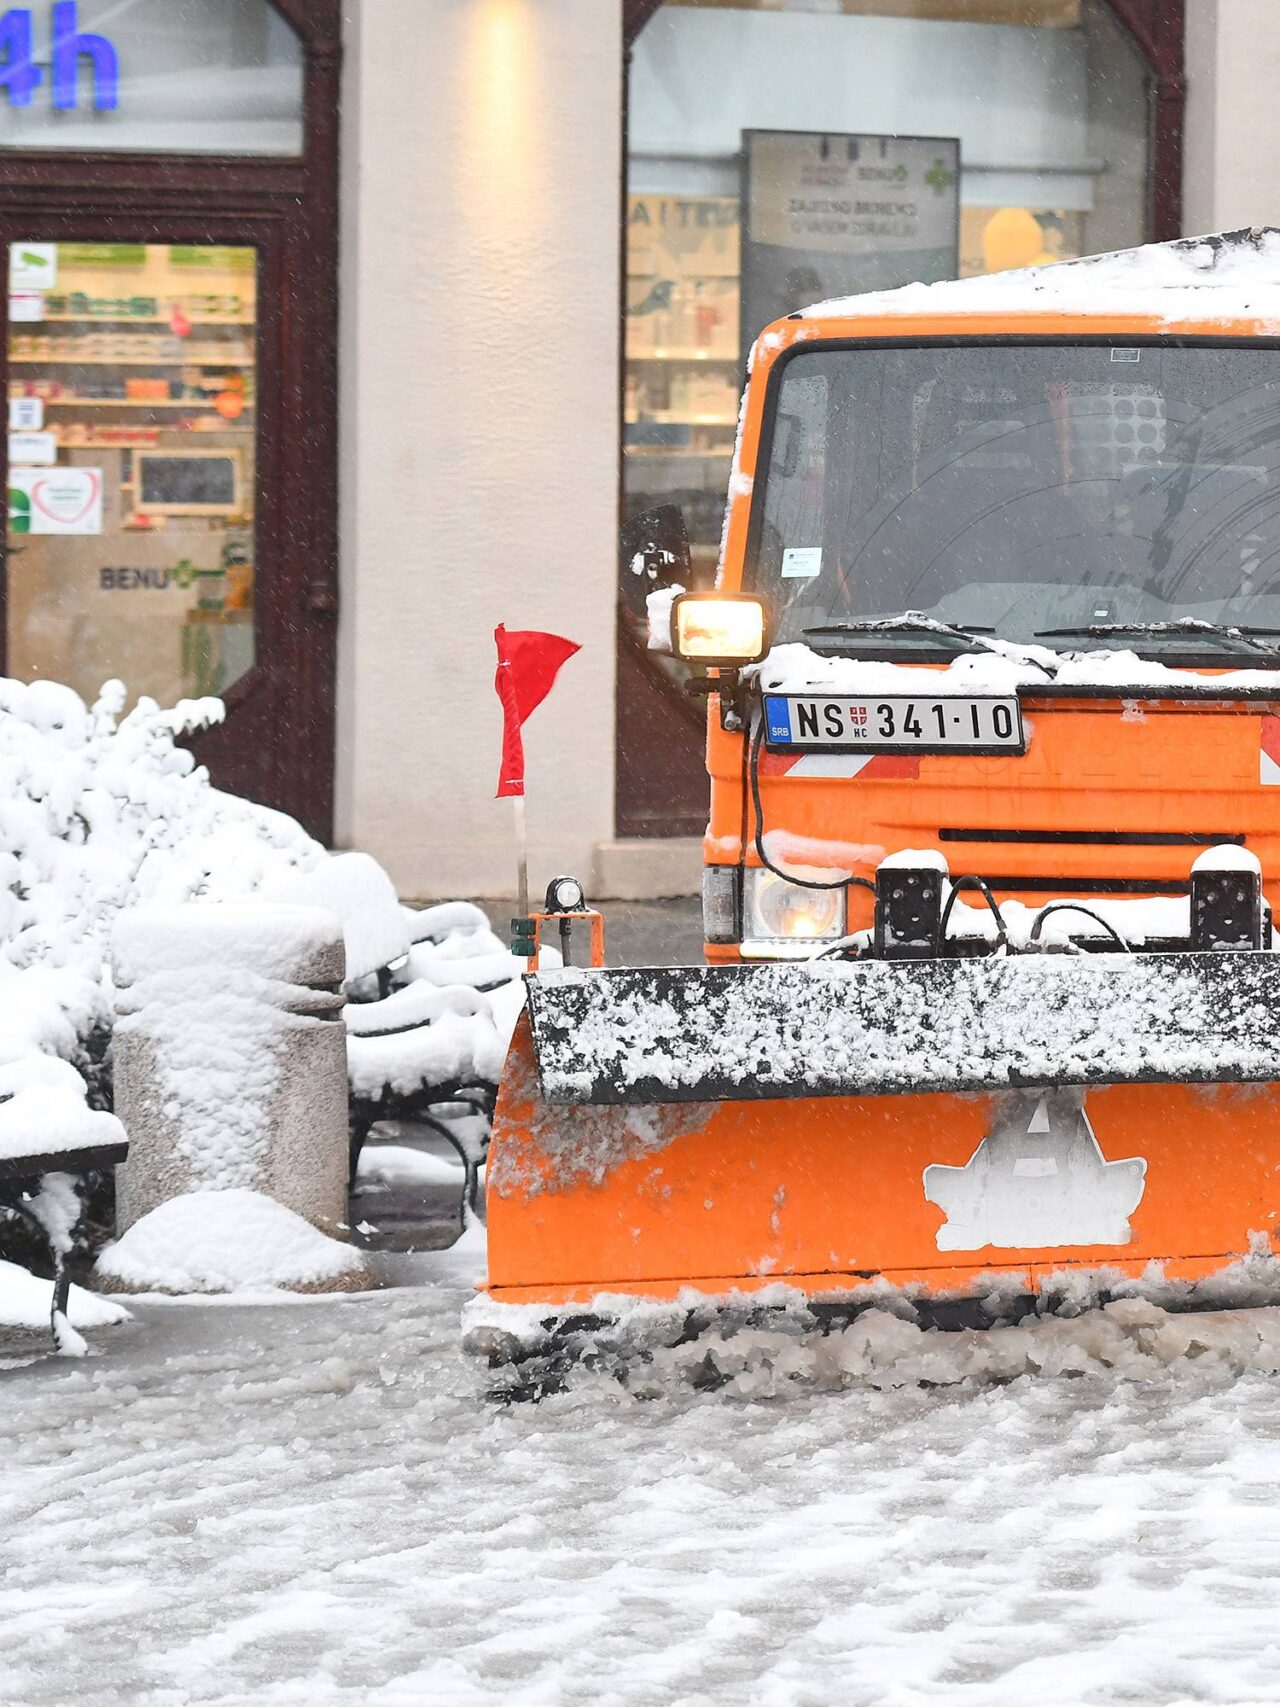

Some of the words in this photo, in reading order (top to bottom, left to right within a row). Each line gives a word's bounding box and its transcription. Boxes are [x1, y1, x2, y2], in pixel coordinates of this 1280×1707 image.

[100, 567, 169, 590] BENU
[771, 726, 790, 737] SRB
[797, 703, 844, 739] NS
